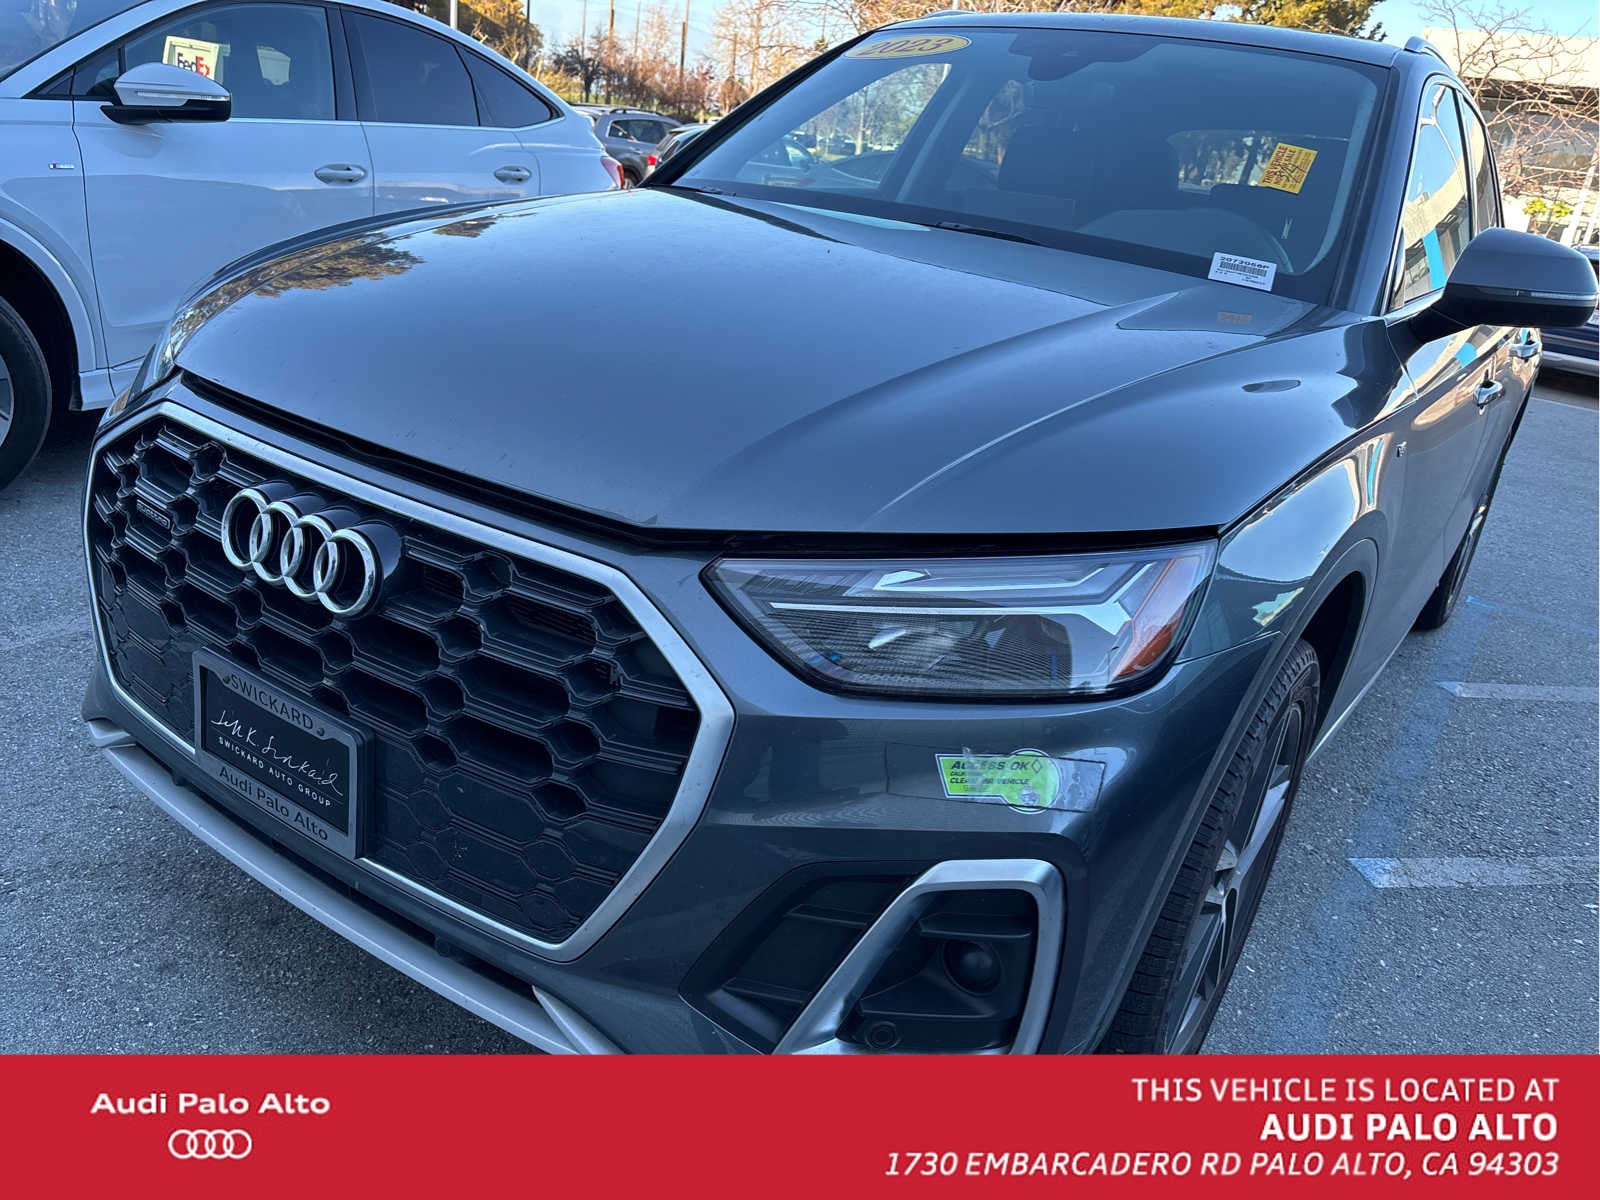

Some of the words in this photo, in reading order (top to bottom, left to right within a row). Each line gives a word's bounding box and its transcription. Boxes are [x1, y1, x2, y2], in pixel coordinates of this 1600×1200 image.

[855, 38, 955, 56] 2023
[1272, 146, 1288, 169] VEHICLE
[231, 674, 314, 731] SWICKARD
[218, 736, 264, 769] SWICKARD
[268, 766, 294, 786] AUTO
[298, 783, 332, 807] GROUP
[1010, 761, 1030, 771] OK
[219, 765, 252, 796] Audi
[257, 787, 290, 817] Palo
[293, 811, 328, 841] Alto
